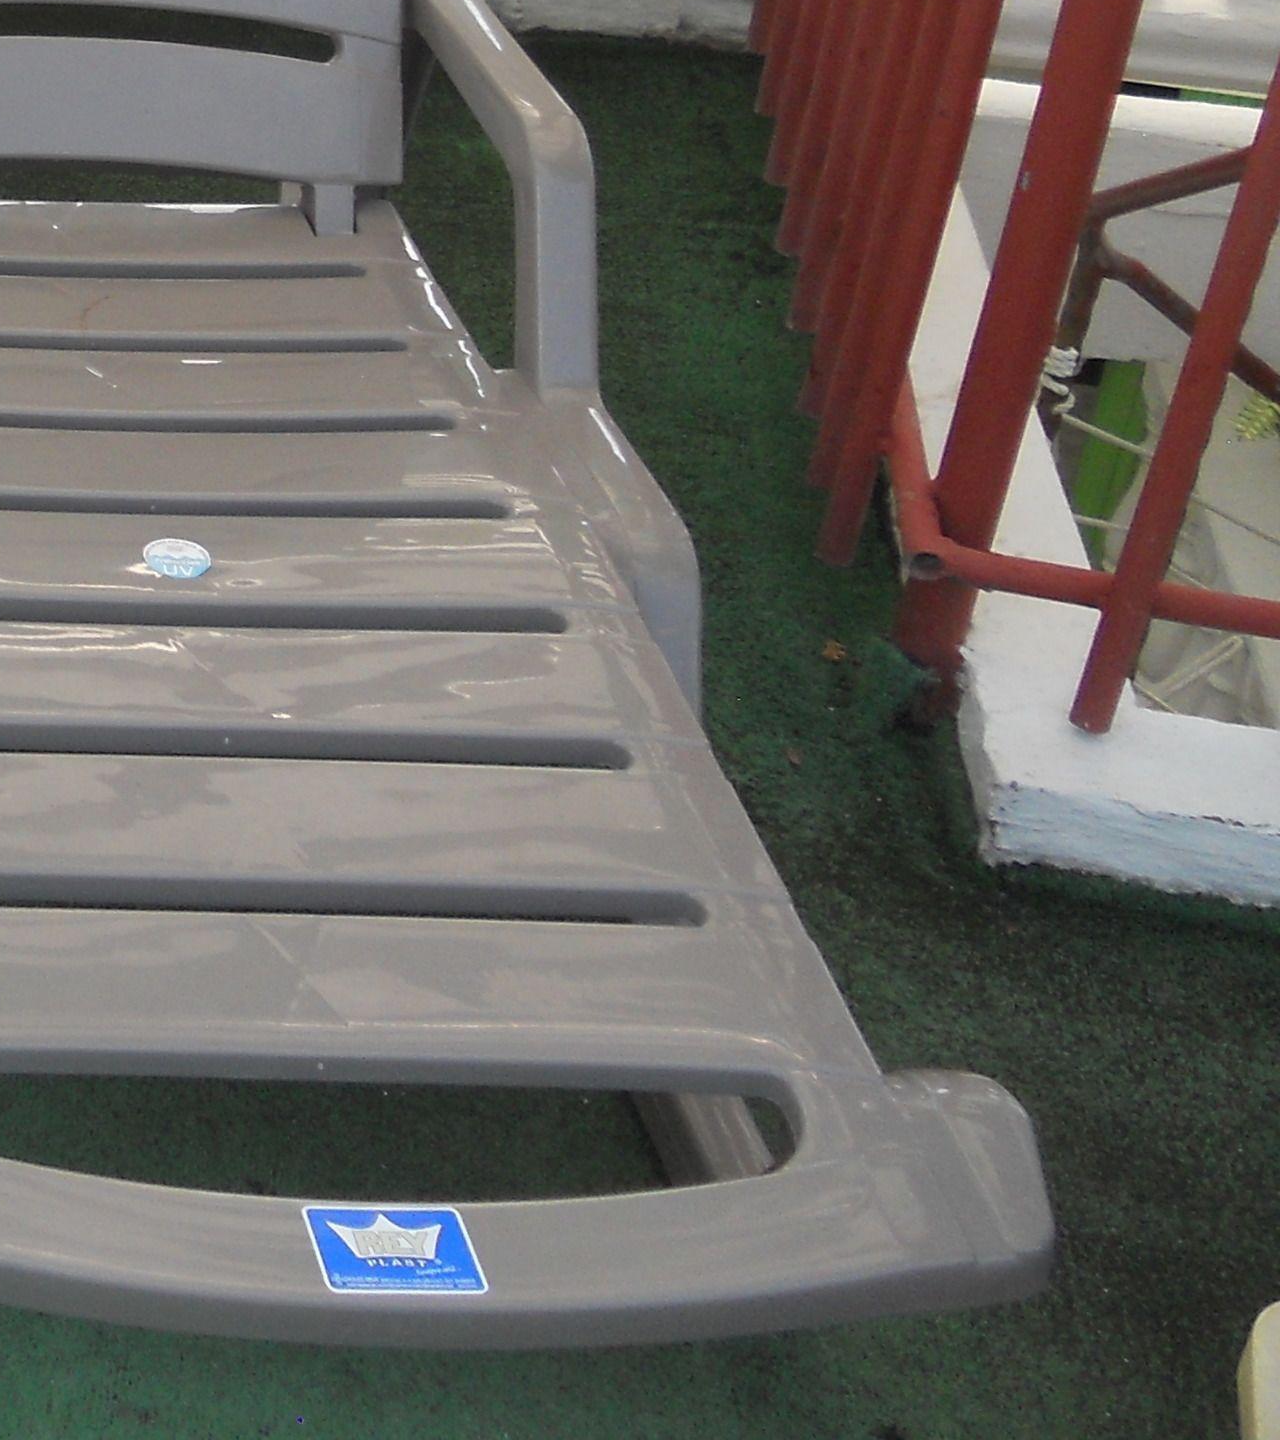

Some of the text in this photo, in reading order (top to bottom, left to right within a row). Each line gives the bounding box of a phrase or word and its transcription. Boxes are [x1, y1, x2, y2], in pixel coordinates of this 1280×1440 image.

[163, 564, 193, 576] UV
[352, 1231, 428, 1256] REY
[367, 1258, 428, 1268] PLAST
